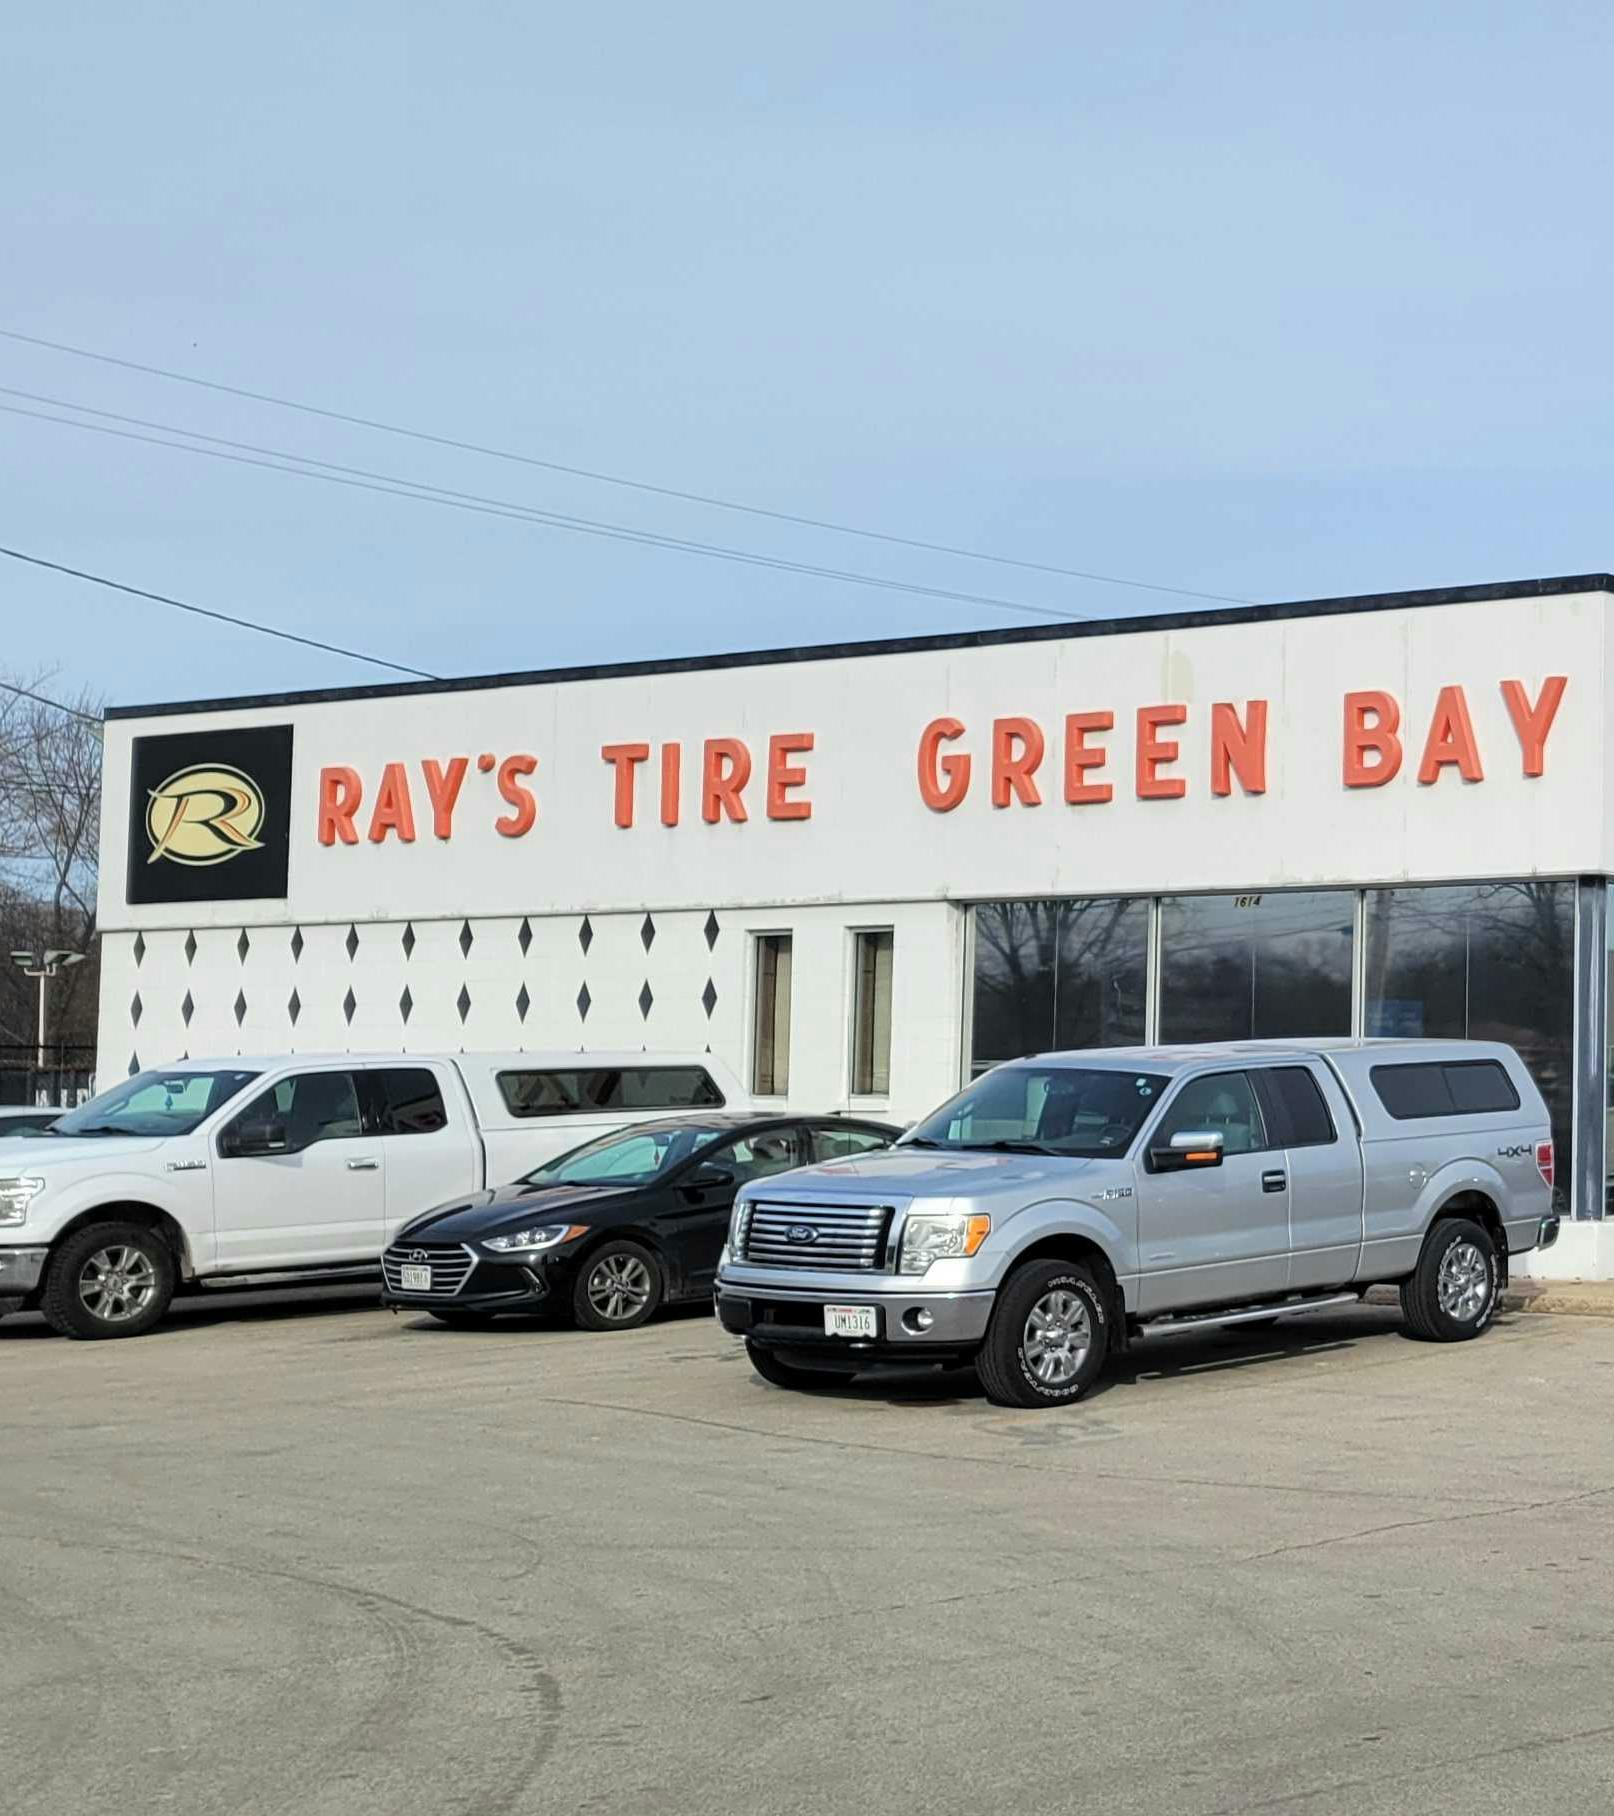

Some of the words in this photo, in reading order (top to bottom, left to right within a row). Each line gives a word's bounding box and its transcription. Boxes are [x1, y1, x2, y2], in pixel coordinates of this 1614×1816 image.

[318, 753, 538, 847] RAY'S
[602, 731, 816, 830] TIRE
[917, 699, 1268, 813] GREEN
[1343, 676, 1568, 789] BAY
[147, 783, 265, 864] R
[1233, 895, 1262, 908] 1614
